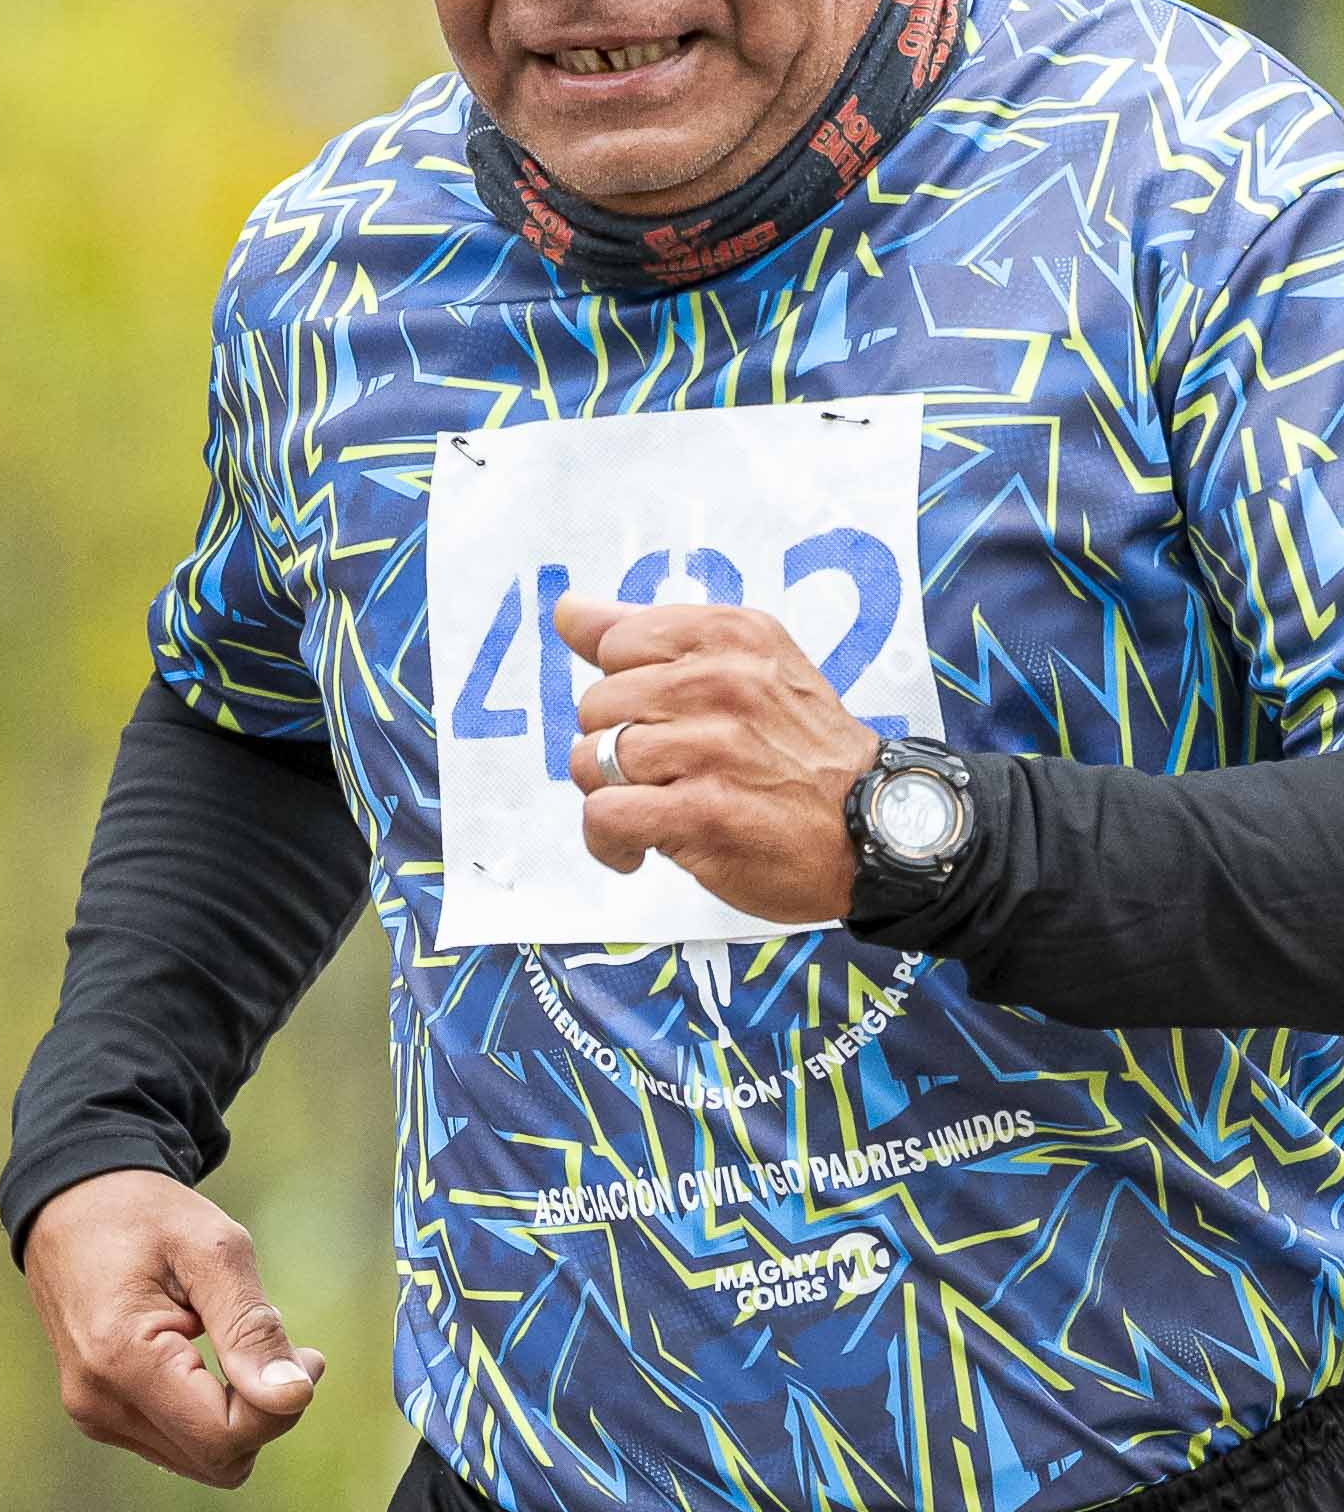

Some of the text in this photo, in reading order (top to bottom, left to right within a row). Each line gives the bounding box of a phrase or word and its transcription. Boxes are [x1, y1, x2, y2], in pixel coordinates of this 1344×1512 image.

[452, 527, 909, 781] 42
[517, 943, 621, 1081] OVIMIENTO,
[630, 1067, 783, 1110] INCLUSIÓN
[781, 1064, 803, 1090] Y
[804, 986, 909, 1080] ENERGÍA
[533, 1109, 1037, 1227] ASOCIACIÓN CIVIL TGD PADRES UNIDOS
[714, 1250, 821, 1292] MAGNY
[736, 1276, 828, 1313] COURS
